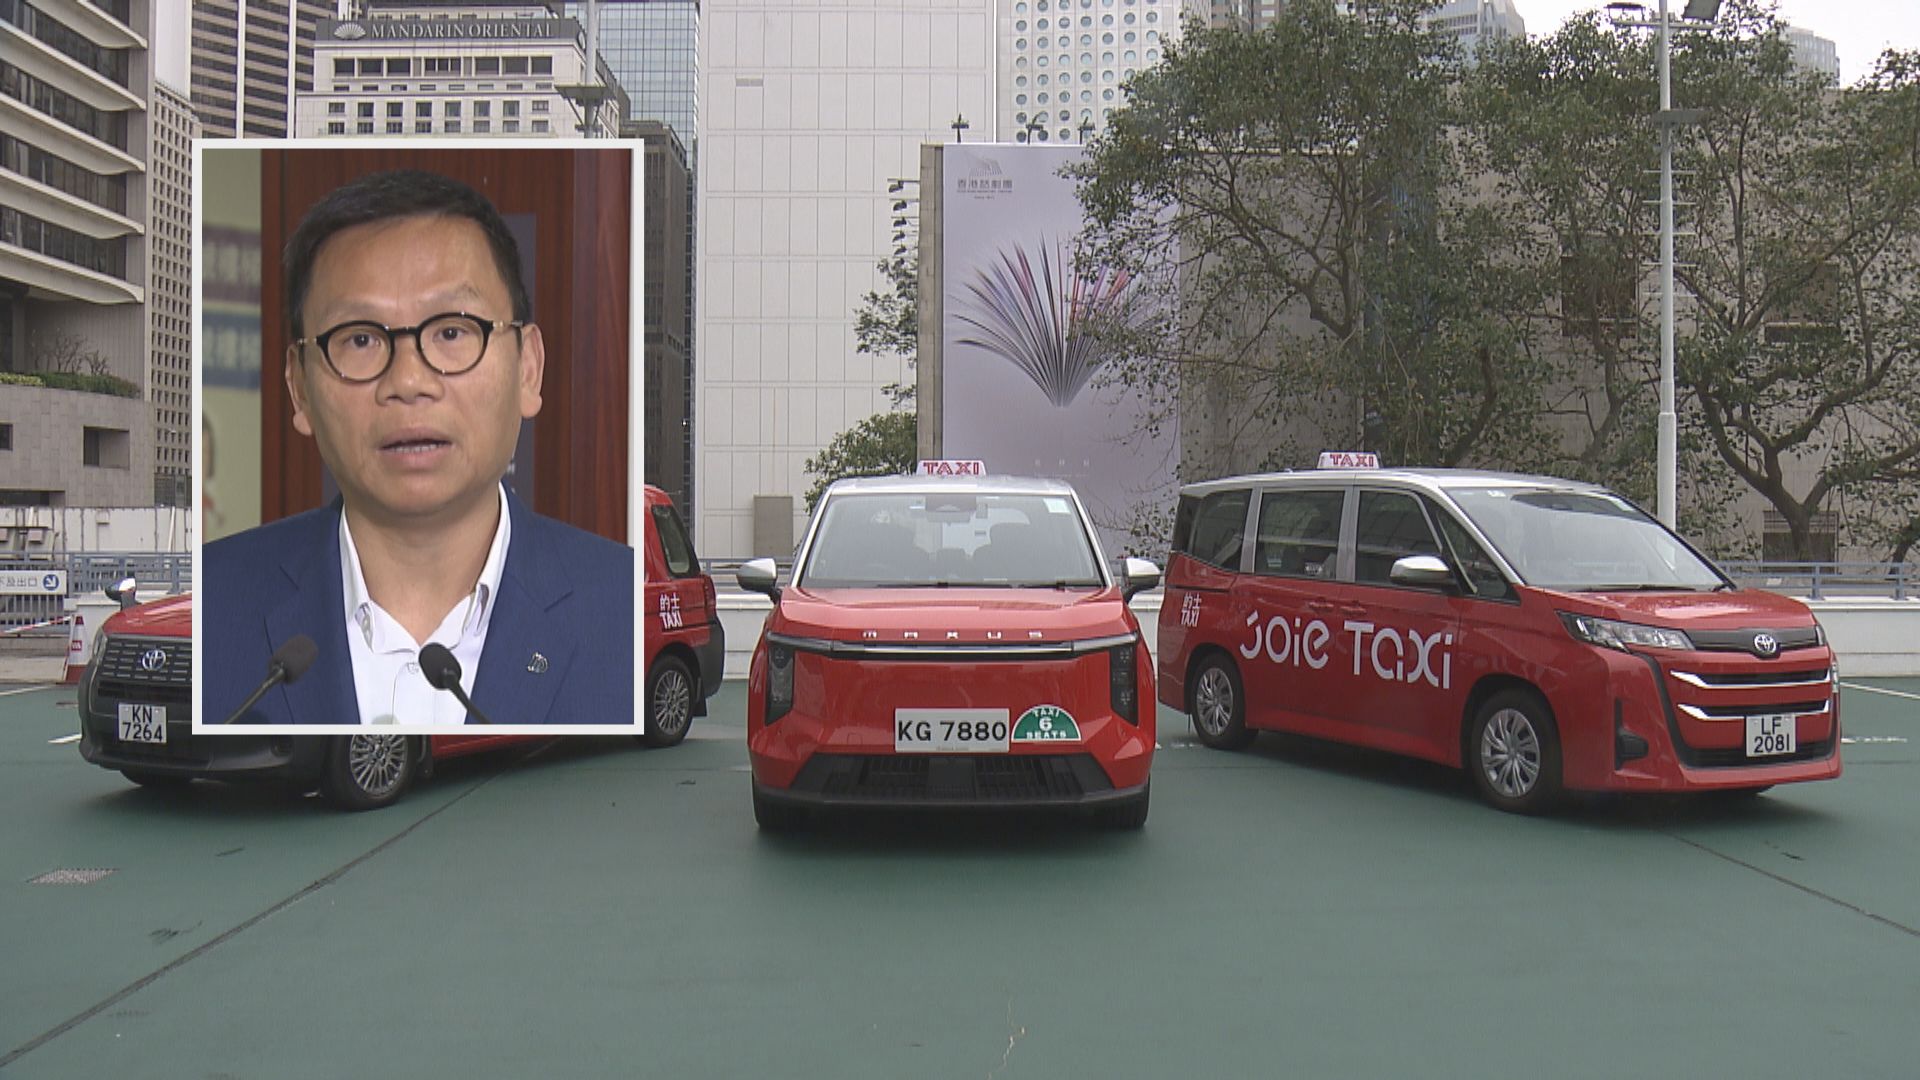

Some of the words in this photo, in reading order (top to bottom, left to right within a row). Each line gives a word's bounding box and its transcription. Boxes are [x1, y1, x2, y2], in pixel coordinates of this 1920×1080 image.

[371, 23, 465, 39] MANDARIN
[468, 22, 555, 38] ORIENTAL
[923, 461, 980, 476] TAXI
[1329, 453, 1374, 468] TAXI
[660, 592, 680, 611] 的士
[1183, 591, 1202, 609] 的士
[659, 611, 683, 629] TAXI
[1181, 608, 1200, 627] TAXI
[132, 705, 153, 723] KN
[1032, 708, 1060, 718] TAXI
[122, 722, 163, 741] 7264
[898, 720, 932, 741] KG
[939, 720, 1007, 741] 7880
[1039, 717, 1053, 732] 6
[1761, 716, 1782, 735] LF
[1026, 731, 1067, 739] SEATS
[1754, 733, 1790, 753] 2081
